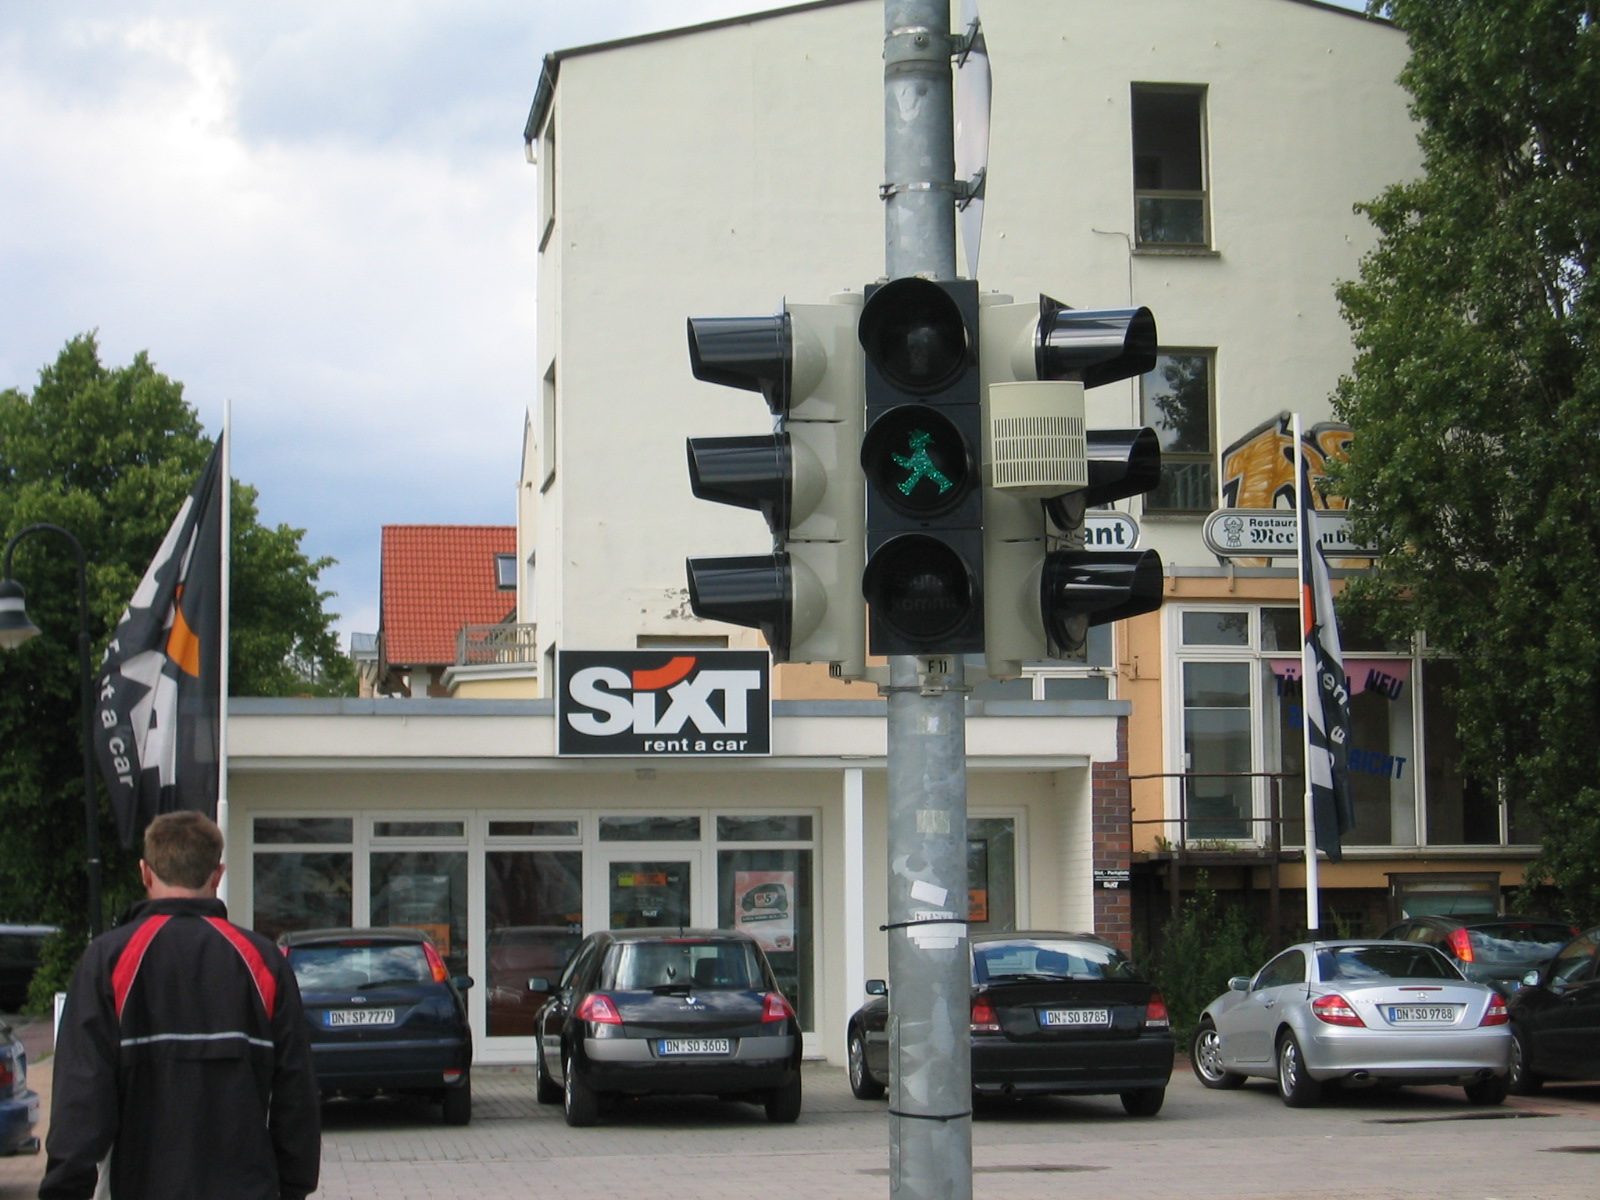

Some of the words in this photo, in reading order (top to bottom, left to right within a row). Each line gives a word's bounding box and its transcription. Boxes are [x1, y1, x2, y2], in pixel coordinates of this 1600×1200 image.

[1364, 668, 1404, 701] NEU
[101, 708, 118, 729] a
[644, 737, 689, 752] rent
[695, 741, 707, 752] a
[713, 740, 748, 752] car
[109, 736, 134, 788] car
[331, 1012, 345, 1024] DN
[352, 1011, 366, 1024] SP
[367, 1010, 393, 1022] 7779
[1048, 1012, 1060, 1023] DN
[1082, 1011, 1106, 1022] 8785
[1396, 1009, 1409, 1020] DN
[1429, 1008, 1453, 1020] 9788
[666, 1041, 680, 1052] DN
[702, 1040, 728, 1051] 3603
